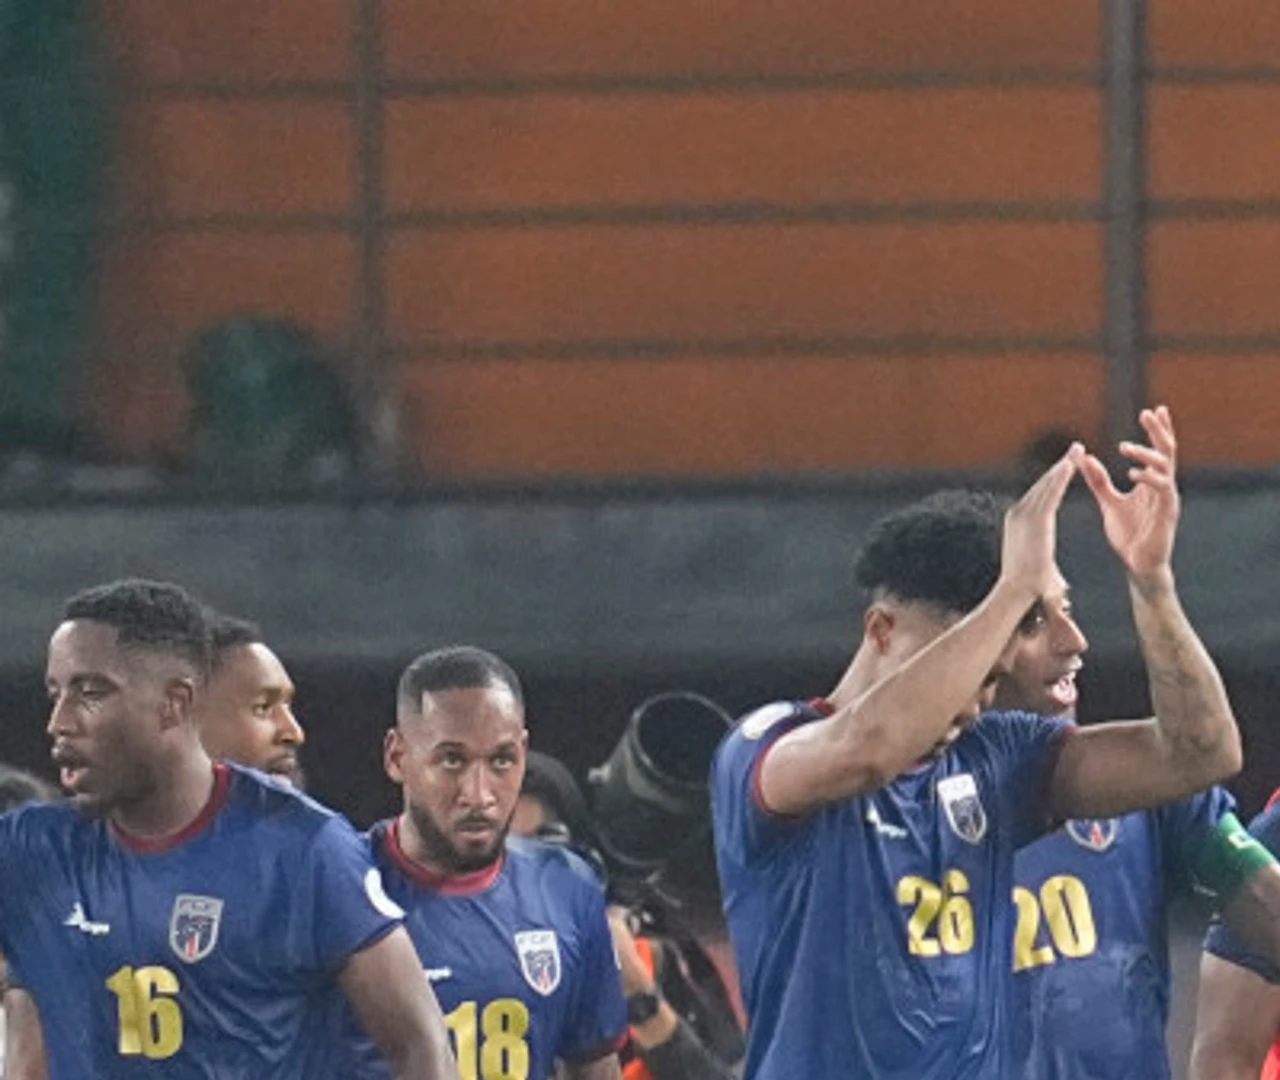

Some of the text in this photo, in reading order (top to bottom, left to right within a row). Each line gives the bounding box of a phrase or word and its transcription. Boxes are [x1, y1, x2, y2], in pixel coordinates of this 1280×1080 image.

[896, 869, 976, 957] 26
[1011, 876, 1097, 972] 20
[106, 965, 184, 1060] 16
